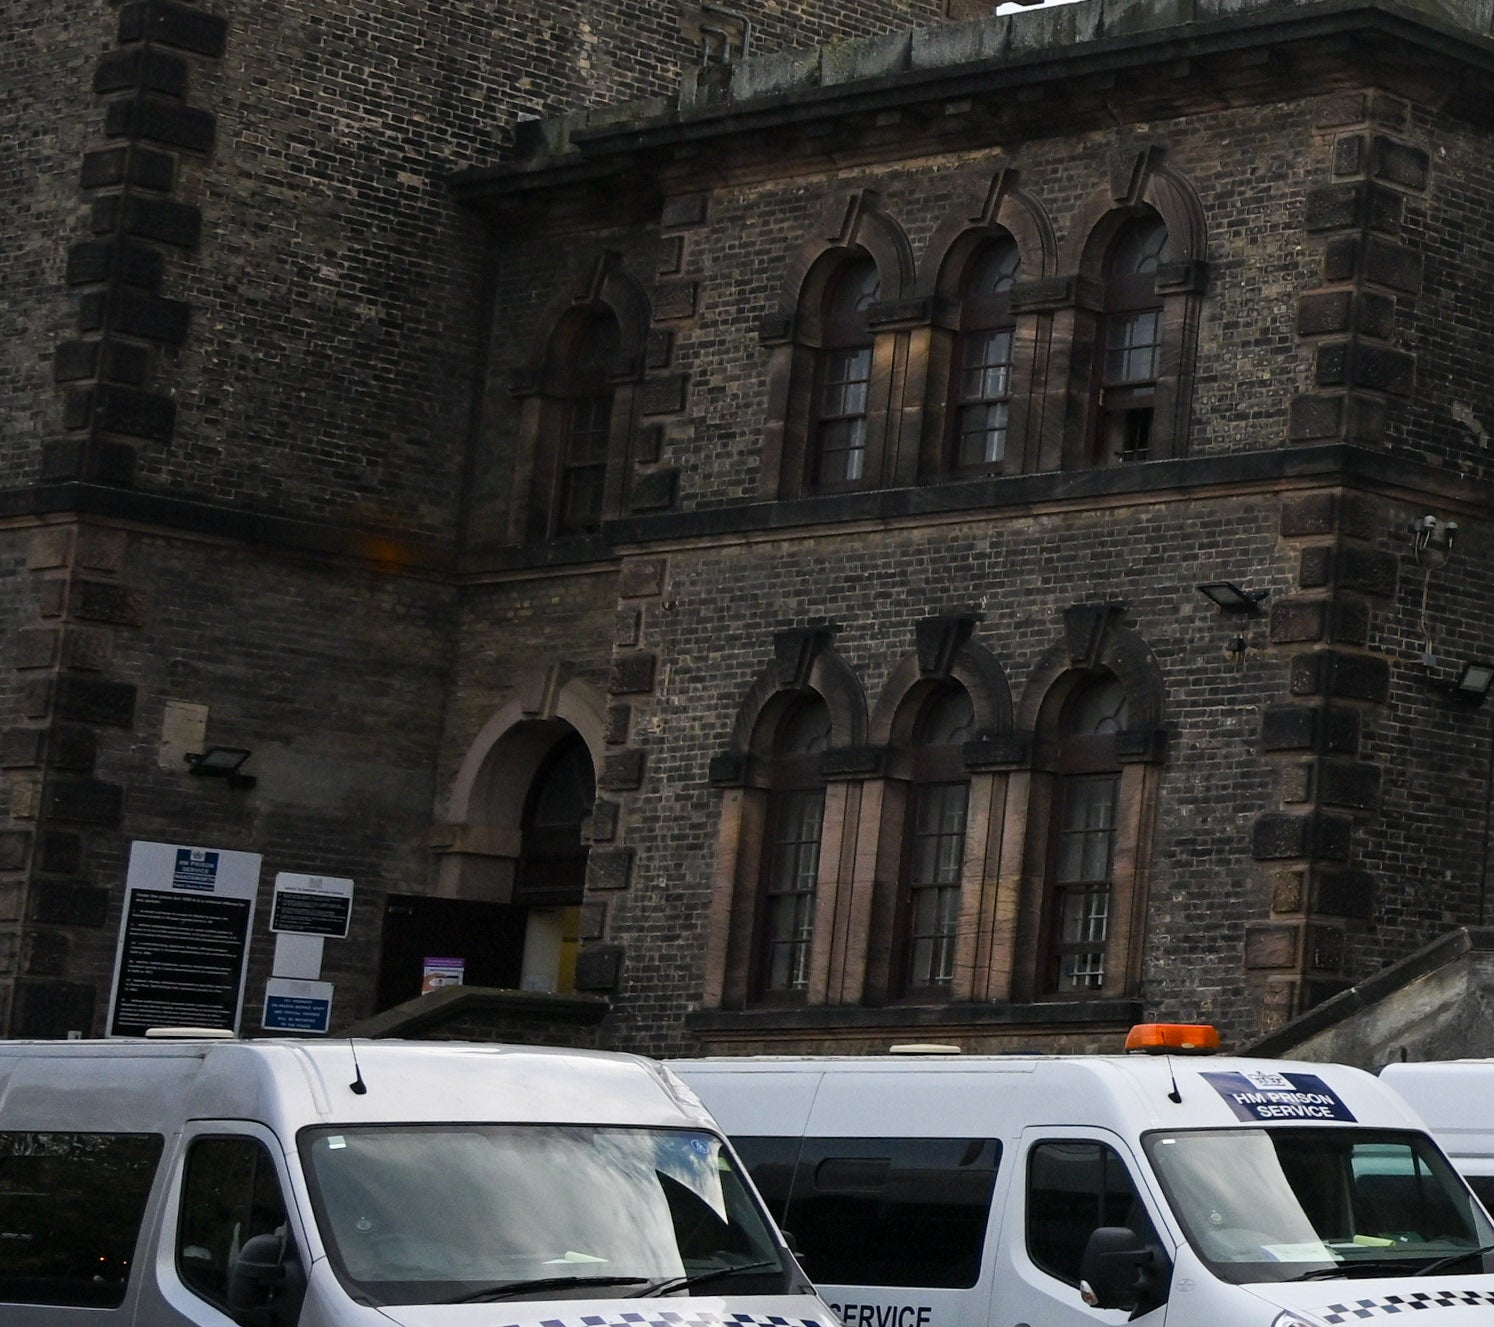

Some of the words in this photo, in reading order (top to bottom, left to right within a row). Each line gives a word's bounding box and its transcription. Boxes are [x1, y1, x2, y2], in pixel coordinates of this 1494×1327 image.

[1231, 1092, 1267, 1105] HM
[1267, 1092, 1336, 1106] PRISON
[1256, 1105, 1336, 1118] SERVICE
